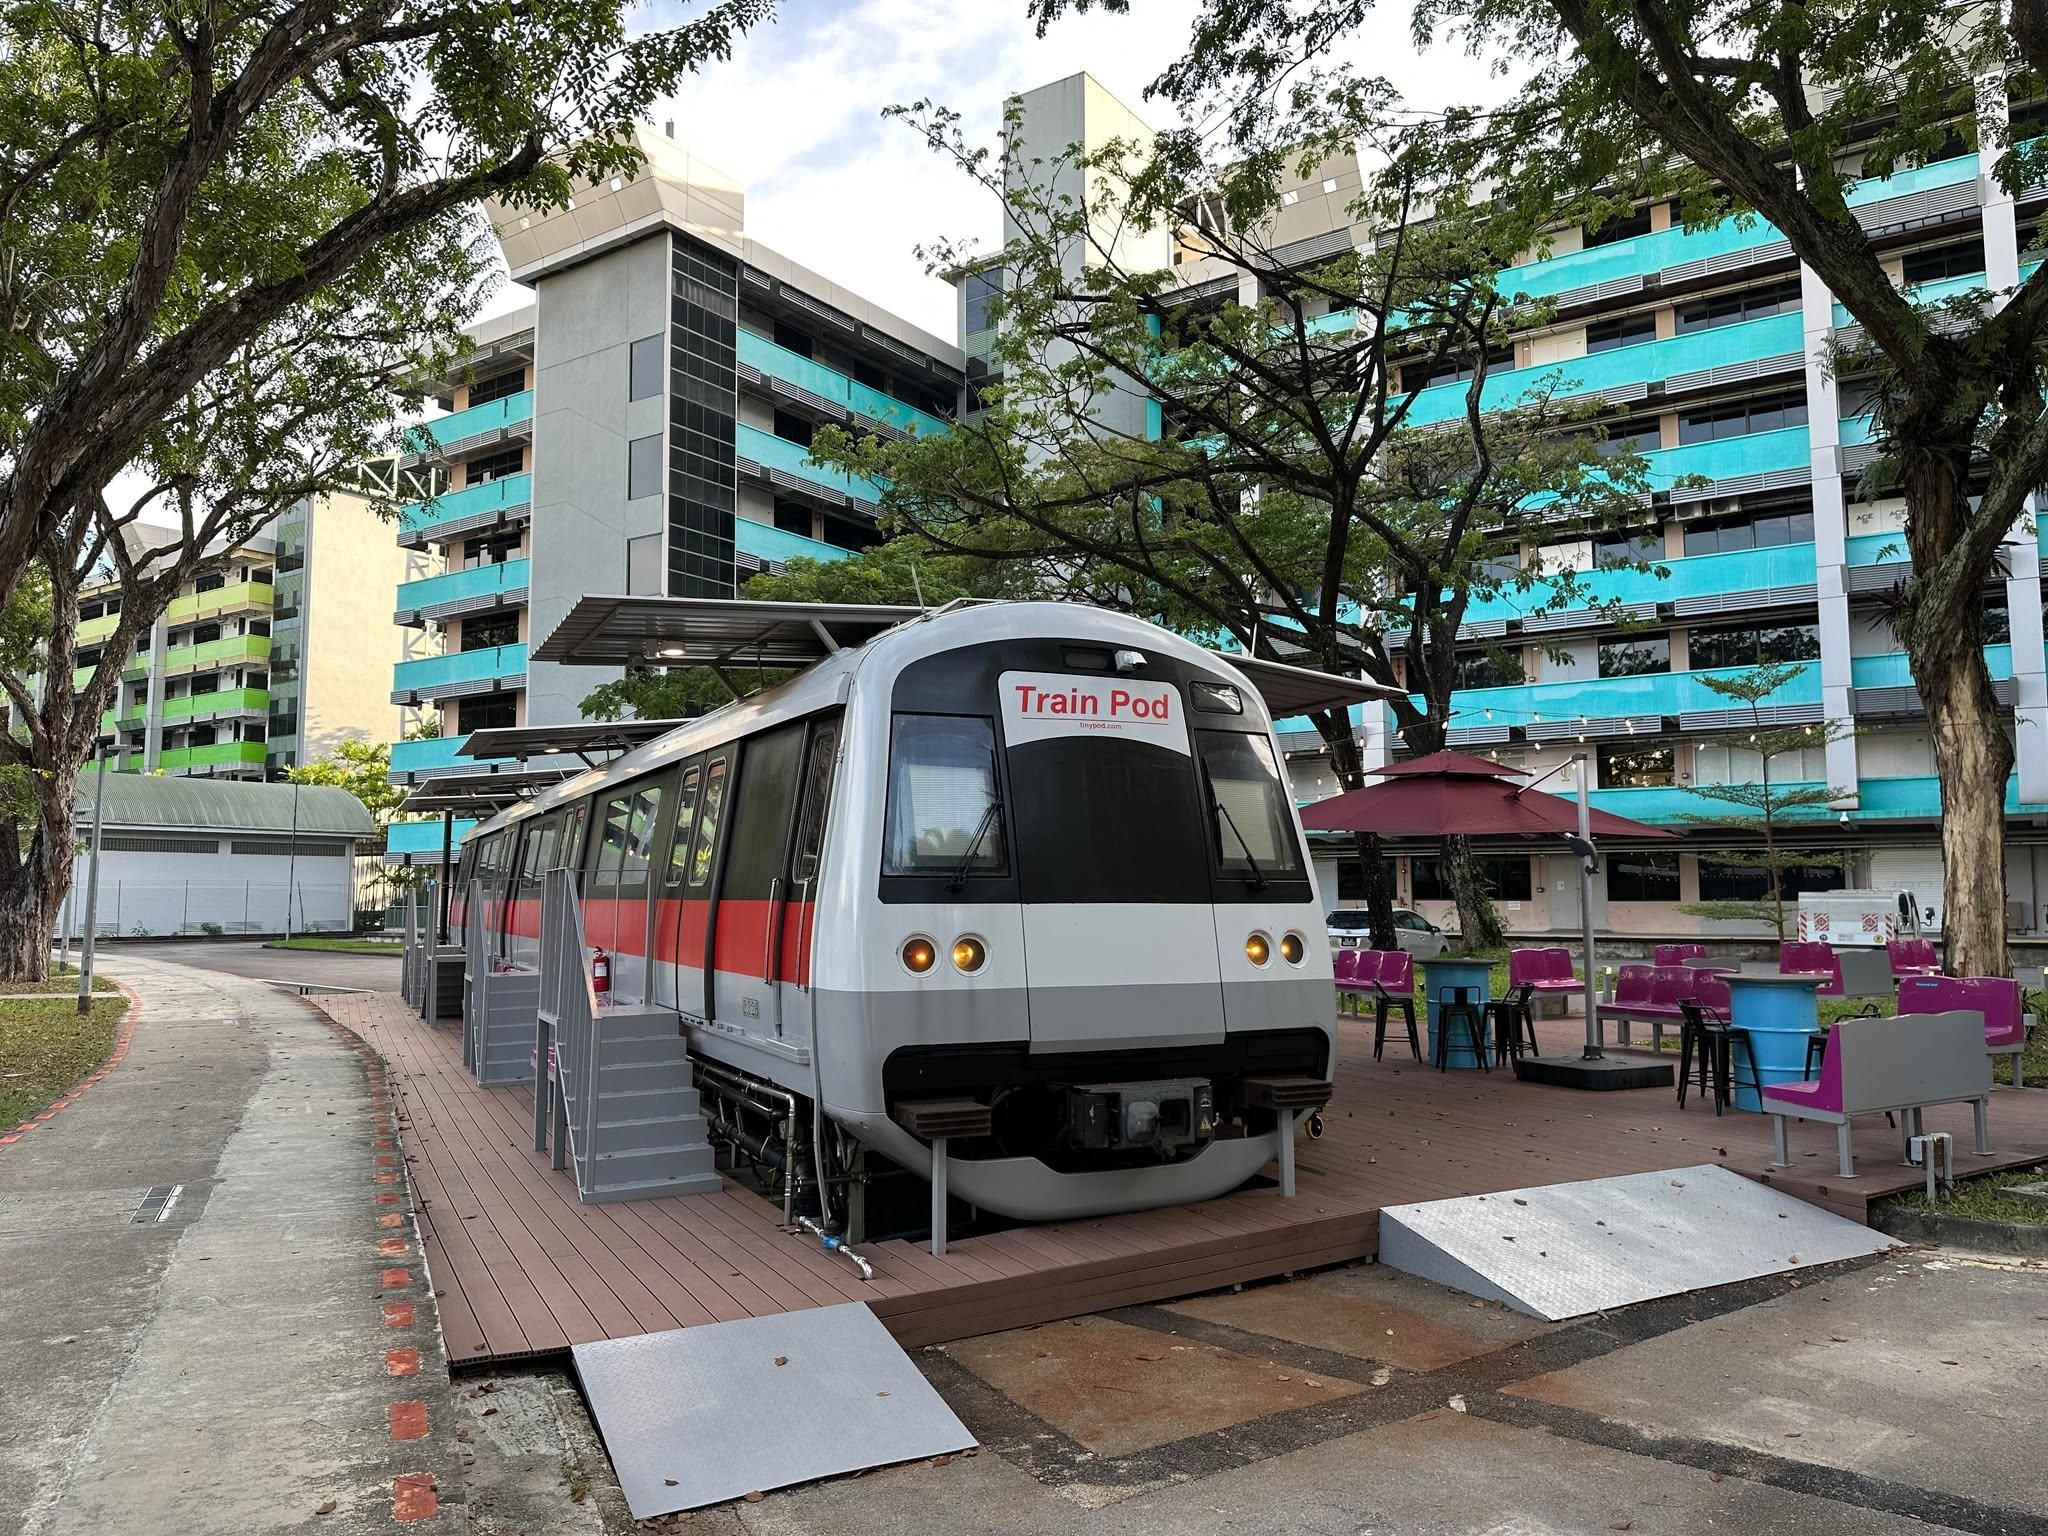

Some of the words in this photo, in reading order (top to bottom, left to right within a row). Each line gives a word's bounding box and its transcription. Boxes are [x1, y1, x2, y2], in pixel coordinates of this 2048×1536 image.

[1015, 685, 1099, 715] Train
[1110, 690, 1169, 720] Pod
[1079, 722, 1122, 730] tinypod.com
